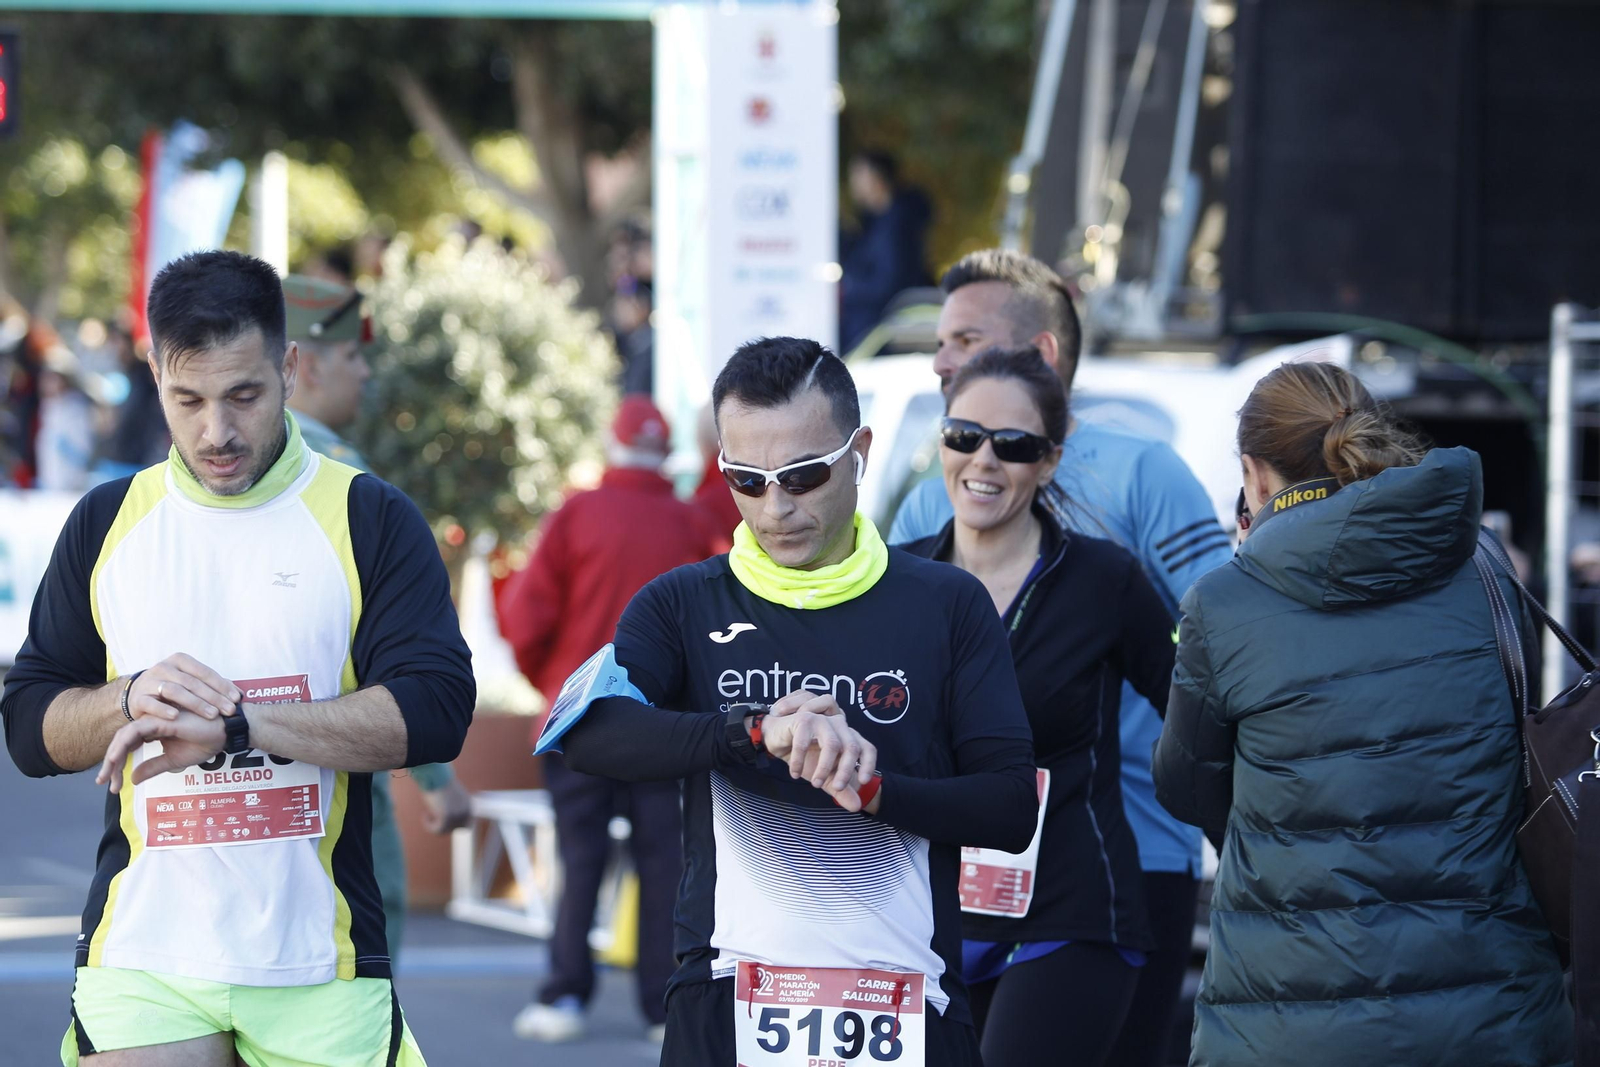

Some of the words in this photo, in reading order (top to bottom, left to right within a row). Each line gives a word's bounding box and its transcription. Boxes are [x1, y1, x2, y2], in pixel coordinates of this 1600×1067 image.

[1273, 487, 1327, 513] Nikon
[246, 685, 301, 699] CARRERA
[184, 774, 199, 786] M.
[204, 768, 273, 785] DELGADO
[247, 782, 274, 790] VALVERDE
[210, 797, 236, 805] ALMERÍA
[779, 973, 806, 981] MEDIO
[779, 981, 820, 990] MARATÓN
[857, 978, 911, 993] CARREA
[778, 989, 815, 998] ALMERÍA
[842, 990, 911, 1006] SALUDAE
[756, 1007, 903, 1062] 5198
